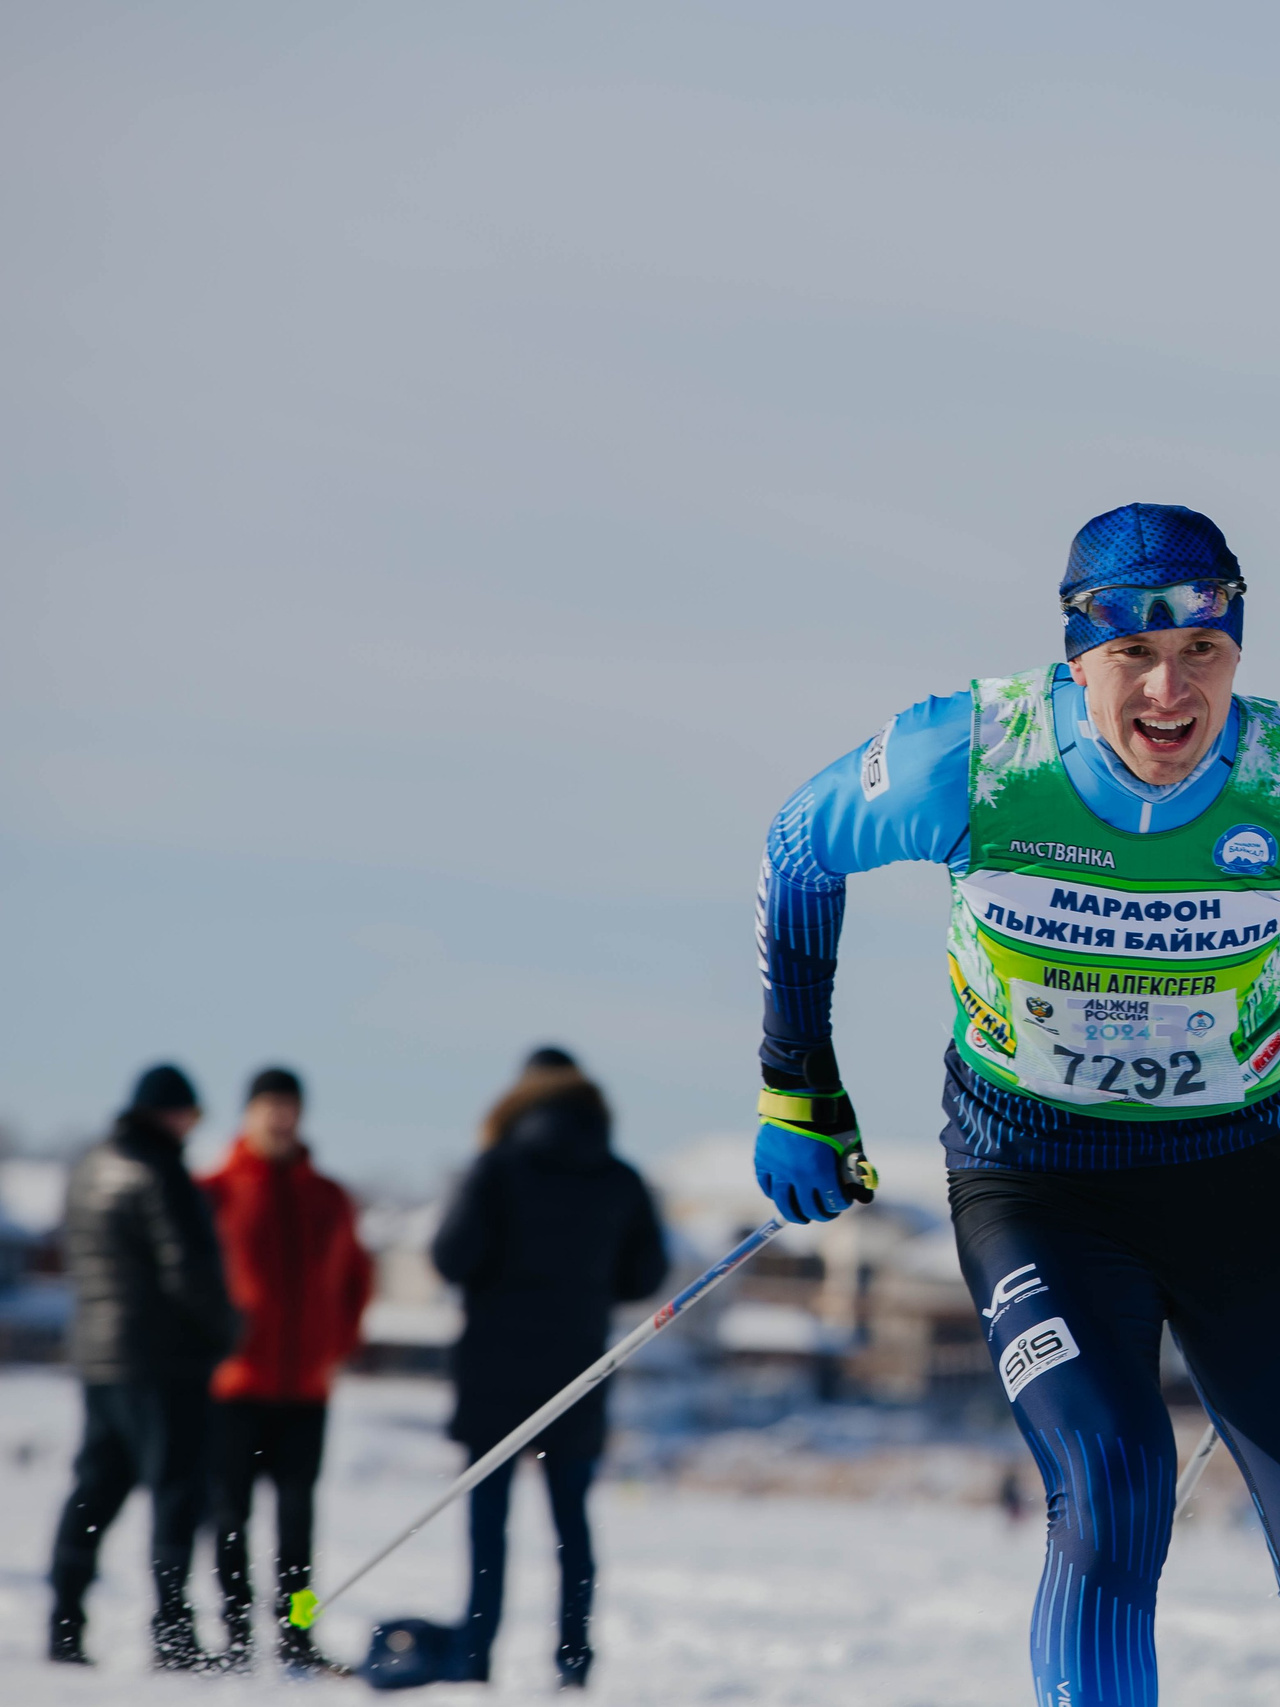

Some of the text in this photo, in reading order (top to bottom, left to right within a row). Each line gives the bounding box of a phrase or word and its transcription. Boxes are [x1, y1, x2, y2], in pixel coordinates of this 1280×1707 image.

[1008, 840, 1116, 869] ЛИСТВЯНКА
[1049, 887, 1221, 922] МАРАФОН
[984, 902, 1279, 952] ЛЫЖНЯ БАЙКАЛА
[1043, 966, 1216, 997] ИВАН АЛЕКСЕЕВ
[1083, 998, 1149, 1014] ЛЫЖНЯ
[1085, 1010, 1149, 1021] РОССИИ
[1085, 1024, 1151, 1041] 2024
[1053, 1044, 1206, 1100] 7292
